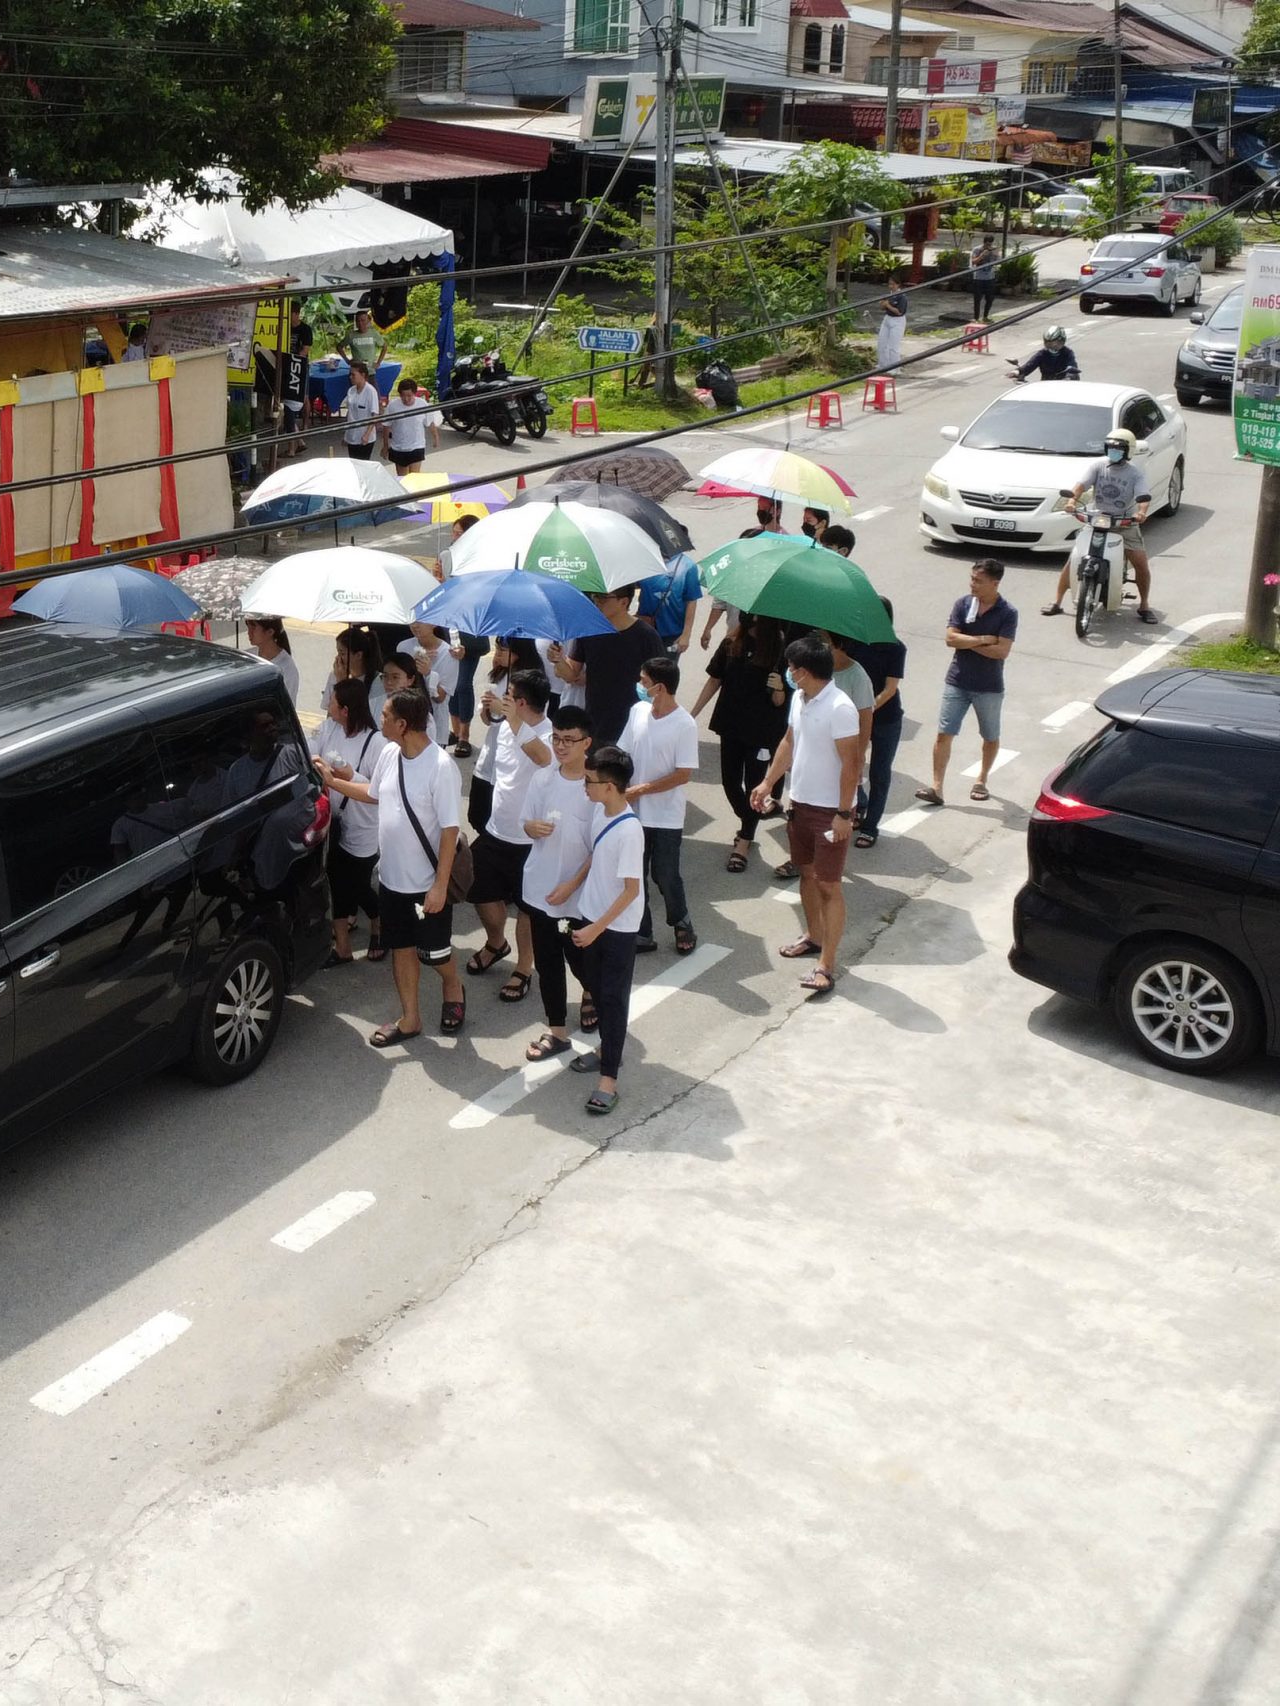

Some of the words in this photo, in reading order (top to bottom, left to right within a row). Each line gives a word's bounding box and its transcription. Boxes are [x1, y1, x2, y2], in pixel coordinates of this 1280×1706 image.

[598, 330, 625, 339] JALAN
[538, 556, 587, 573] Carlsberg
[332, 589, 383, 605] Carlsberg
